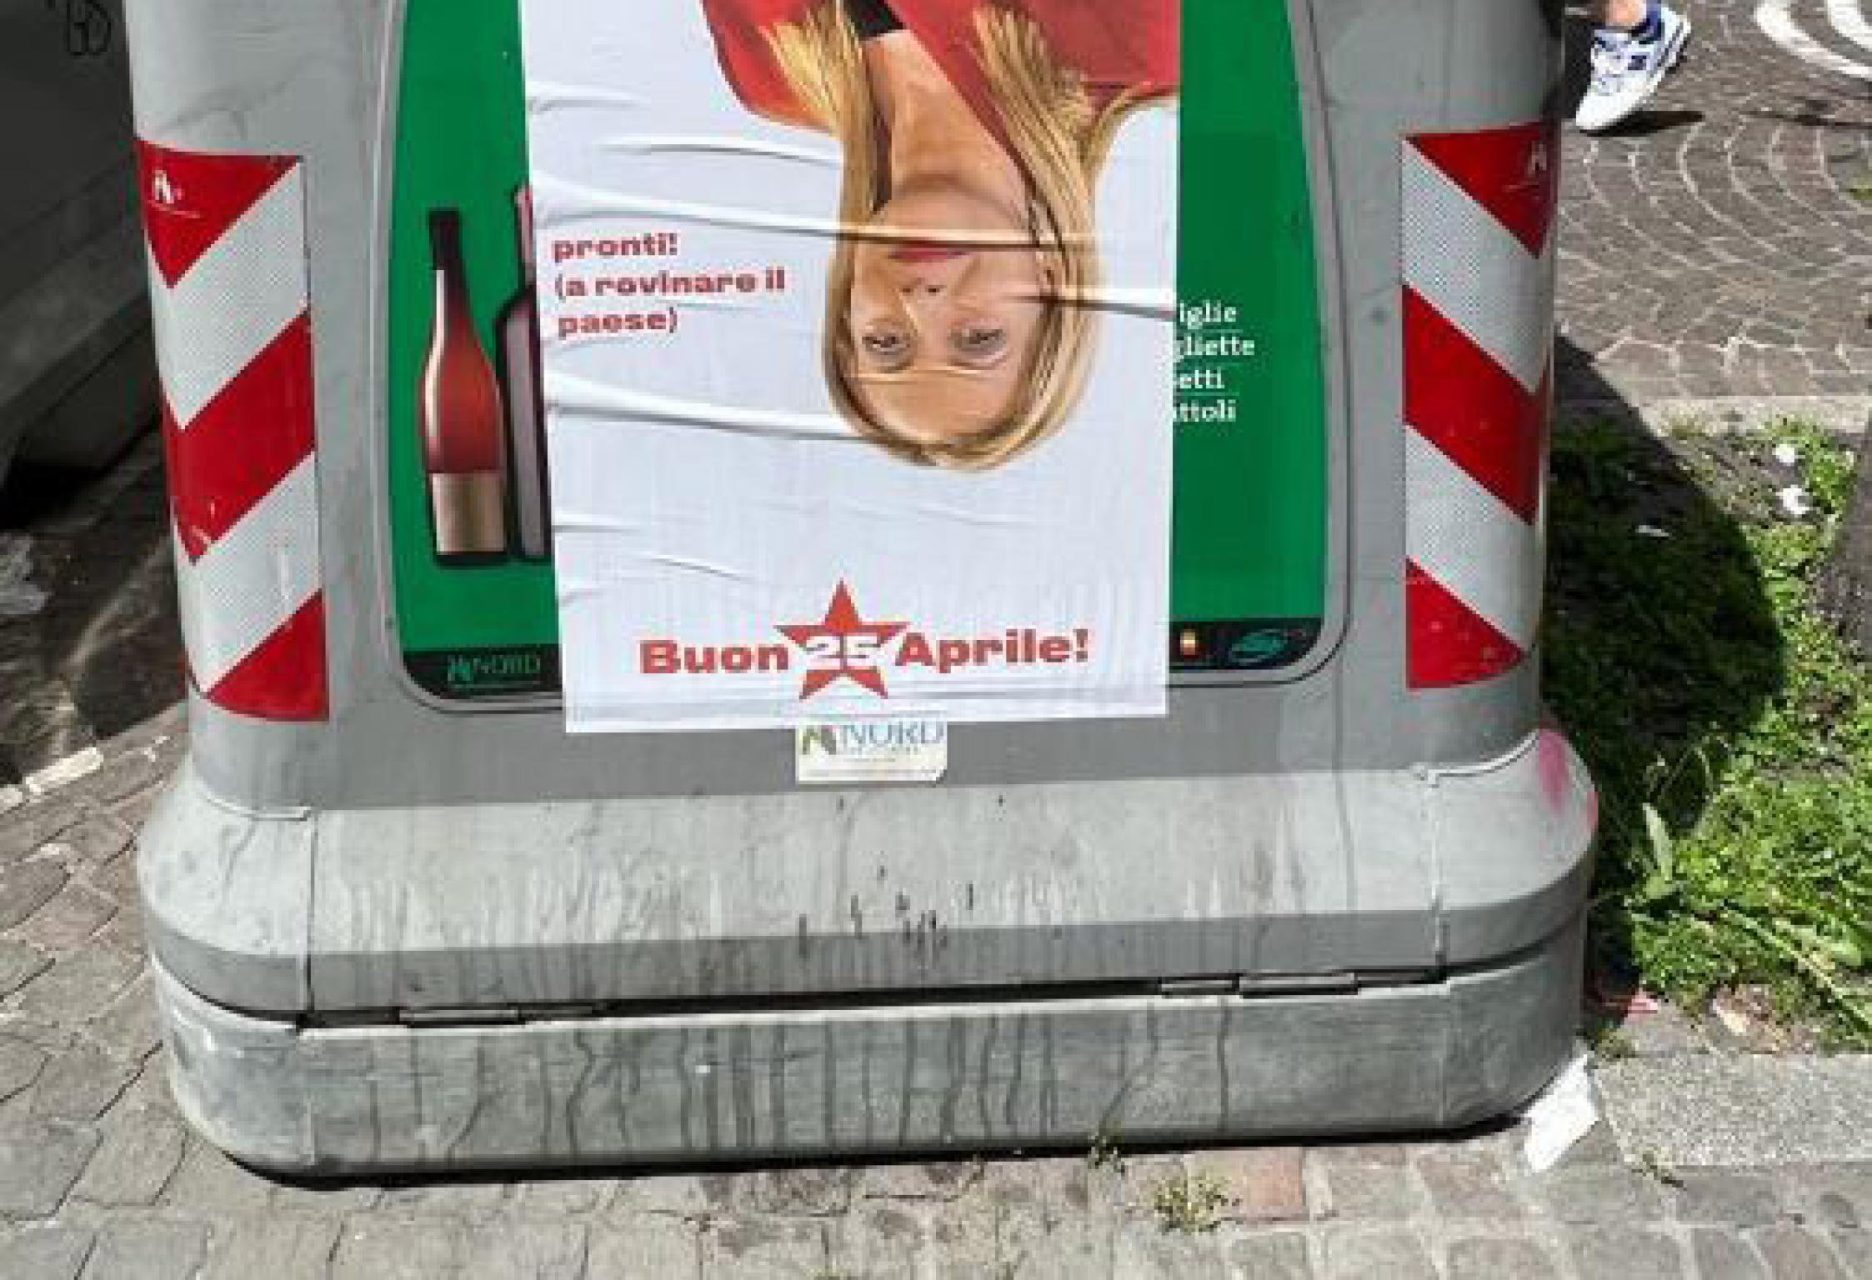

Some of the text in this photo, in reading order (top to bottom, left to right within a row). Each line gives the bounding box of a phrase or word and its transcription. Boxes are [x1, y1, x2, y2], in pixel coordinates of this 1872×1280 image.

[553, 232, 678, 262] pronti!
[554, 266, 785, 301] (a rovinare il
[558, 306, 678, 337] paese)
[1174, 367, 1225, 389] etti
[639, 628, 1091, 675] Buon 25 Aprile!
